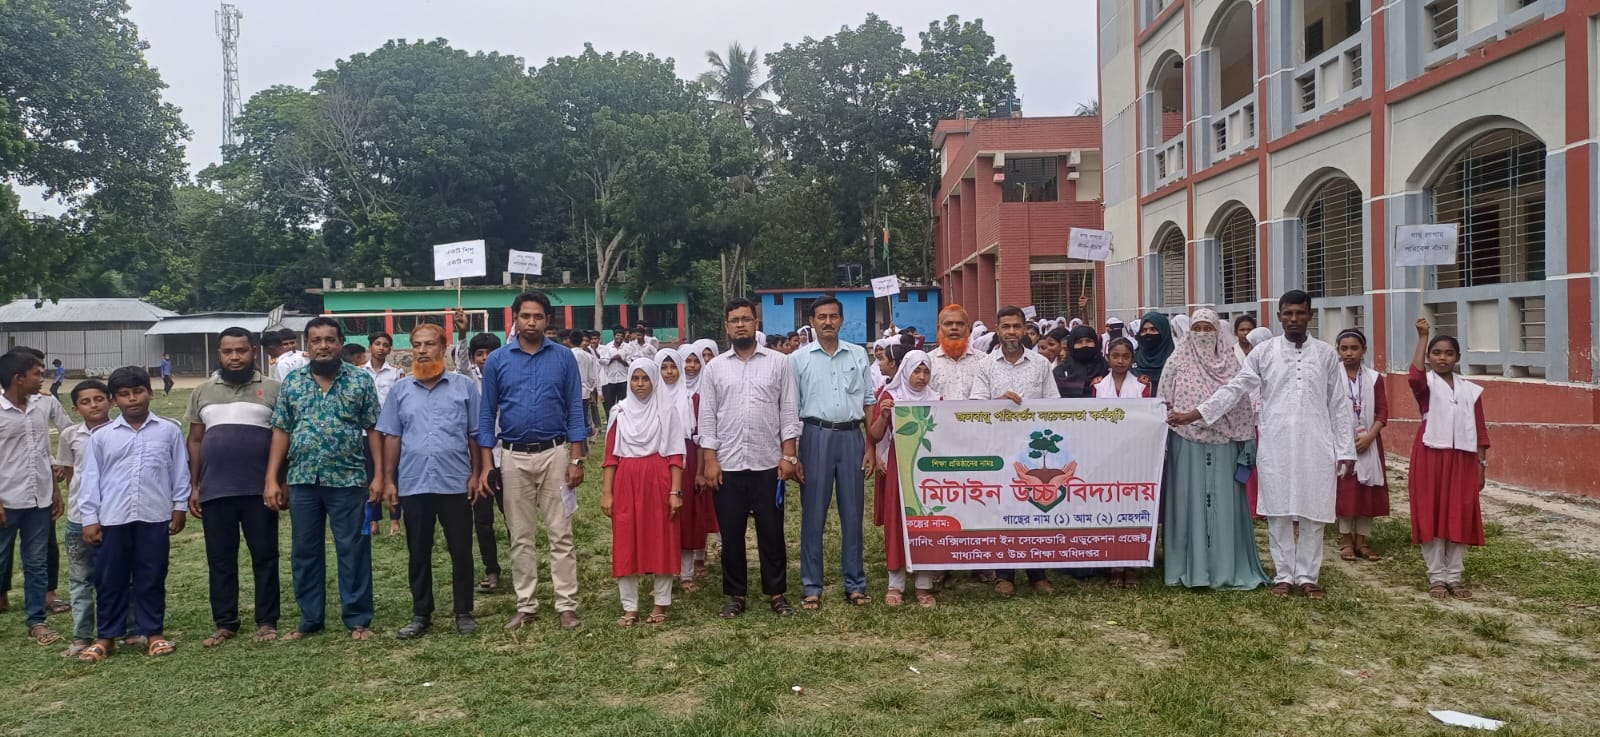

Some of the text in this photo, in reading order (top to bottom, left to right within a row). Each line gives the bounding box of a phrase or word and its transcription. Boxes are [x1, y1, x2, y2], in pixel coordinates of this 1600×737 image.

[955, 411, 993, 424] জলবায়ু
[995, 408, 1036, 422] পরিবর্তন
[1037, 410, 1088, 422] সচেতনতা
[932, 459, 948, 468] শিক্ষা
[949, 459, 979, 468] প্রতিষ্ঠানের
[919, 477, 1159, 507] মিটাইন উচ্চ বিদ্যালয়
[1003, 510, 1151, 526] গাছের নাম (১) আম (২) মেহগনী
[938, 535, 997, 547] এক্সিলারেশন
[1000, 535, 1015, 546] ইন
[1071, 535, 1115, 546] এডুকেশন
[951, 549, 992, 560] মাধ্যমিক
[996, 551, 1005, 560] ও
[1008, 549, 1027, 560] উচ্চ
[1031, 548, 1056, 559] শিক্ষা
[1059, 548, 1101, 558] অধিদপ্তর
